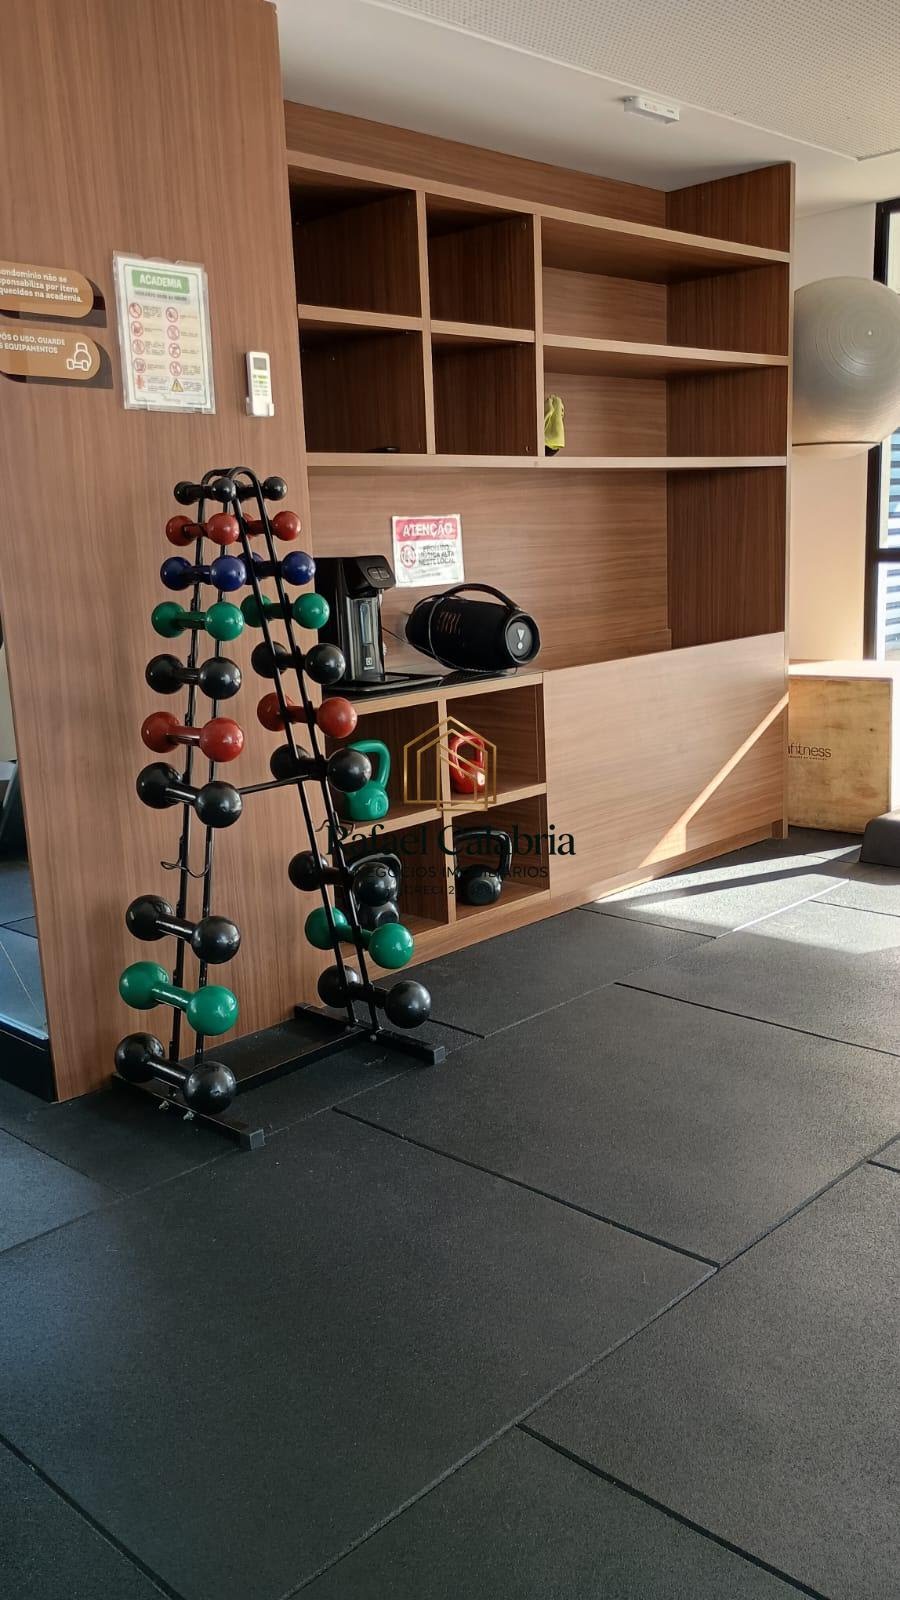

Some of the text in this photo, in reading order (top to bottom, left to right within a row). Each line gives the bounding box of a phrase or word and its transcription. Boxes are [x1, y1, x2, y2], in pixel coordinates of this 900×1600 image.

[45, 283, 58, 292] por
[139, 273, 183, 289] ACADEMIA
[0, 332, 12, 341] ÓS
[37, 336, 66, 346] GUARDE
[5, 343, 58, 354] EQUIPAMENTOS
[402, 520, 453, 538] ATENÇÃO
